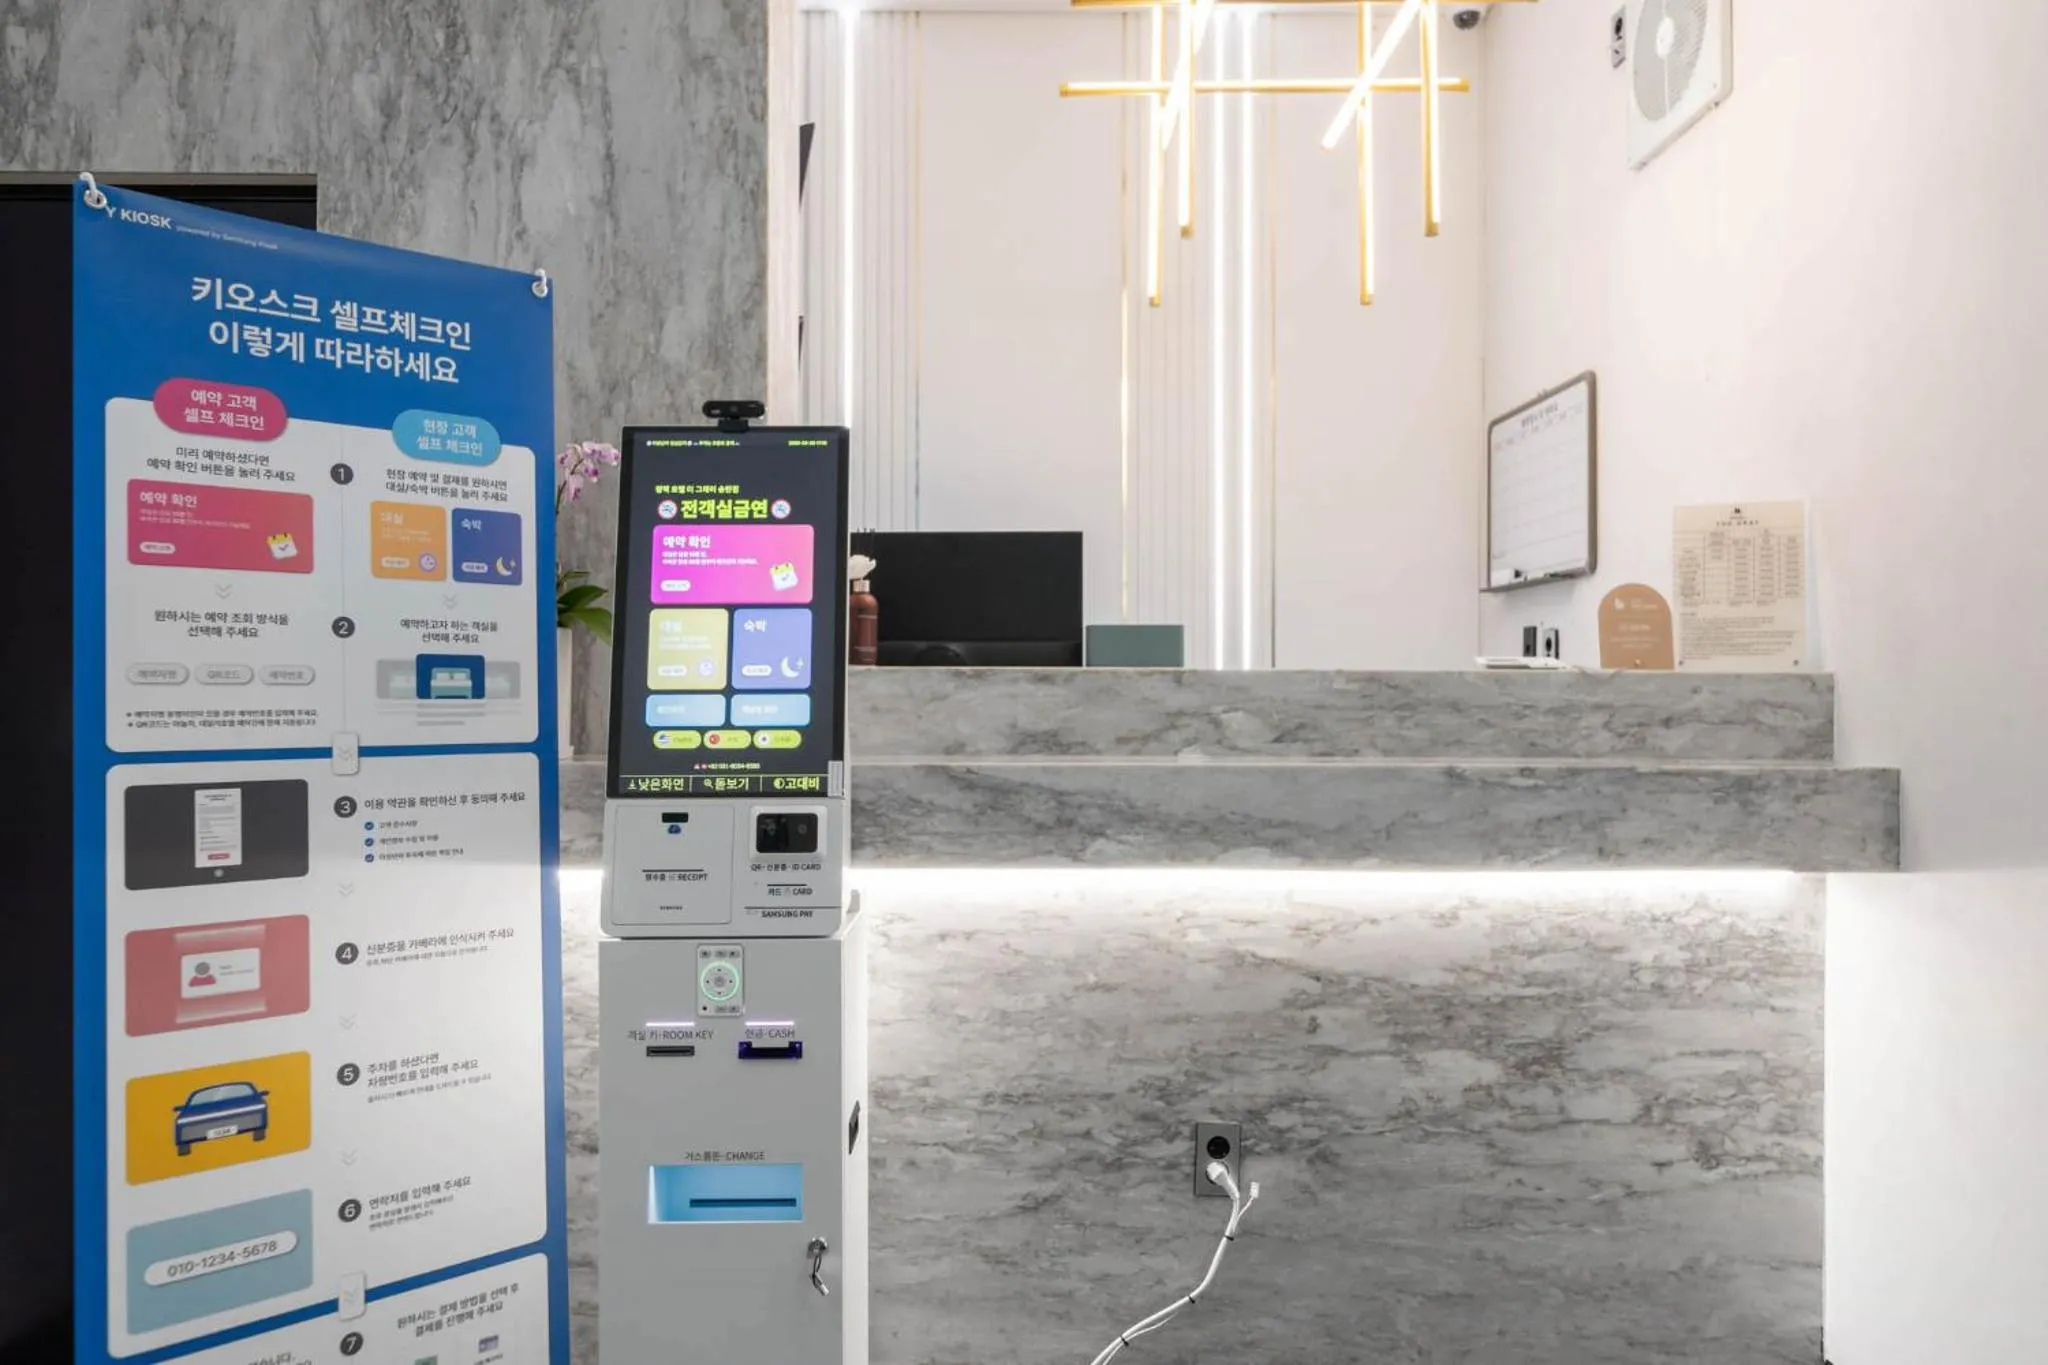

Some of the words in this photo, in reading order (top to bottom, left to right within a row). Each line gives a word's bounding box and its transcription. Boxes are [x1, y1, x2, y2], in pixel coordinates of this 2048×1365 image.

[120, 208, 172, 230] KIOSK
[191, 277, 321, 323] 키오스크
[329, 300, 471, 351] 셀프체크인
[209, 320, 304, 363] 이렇게
[314, 337, 460, 384] 따라하세요
[191, 389, 223, 408] 예약
[227, 394, 257, 412] 고객
[184, 407, 215, 424] 셀프
[219, 411, 265, 431] 체크인
[423, 419, 448, 435] 현장
[452, 423, 477, 439] 고객
[416, 435, 442, 451] 셀프
[445, 439, 483, 457] 체크인
[176, 447, 200, 459] 미리
[202, 450, 270, 467] 예약하셨다면
[147, 457, 171, 470] 예약
[175, 460, 198, 474] 확인
[200, 462, 234, 477] 버튼을
[263, 468, 296, 482] 주세요
[408, 470, 428, 482] 예약
[140, 491, 168, 506] 예약
[171, 494, 197, 508] 확인
[481, 490, 508, 502] 주세요
[680, 499, 769, 519] 전객실금연
[460, 518, 482, 531] 숙박
[662, 535, 687, 548] 예약
[688, 535, 711, 549] 확인
[155, 609, 201, 623] 원하시는
[204, 611, 229, 624] 예약
[256, 613, 288, 626] 방식을
[188, 626, 223, 638] 선택해
[225, 626, 259, 638] 주세요
[452, 633, 479, 643] 주세요
[785, 776, 820, 791] 고대비
[364, 798, 384, 810] 이용
[459, 794, 468, 806] 후
[500, 791, 526, 803] 주세요
[792, 887, 813, 896] CARD
[761, 910, 798, 918] SAMSUNG
[367, 940, 406, 957] 신분증을
[488, 928, 514, 940] 주세요
[695, 1030, 714, 1040] KEY
[451, 1059, 478, 1074] 주세요
[443, 1176, 471, 1190] 주세요
[166, 1239, 277, 1278] 010-1234-5678
